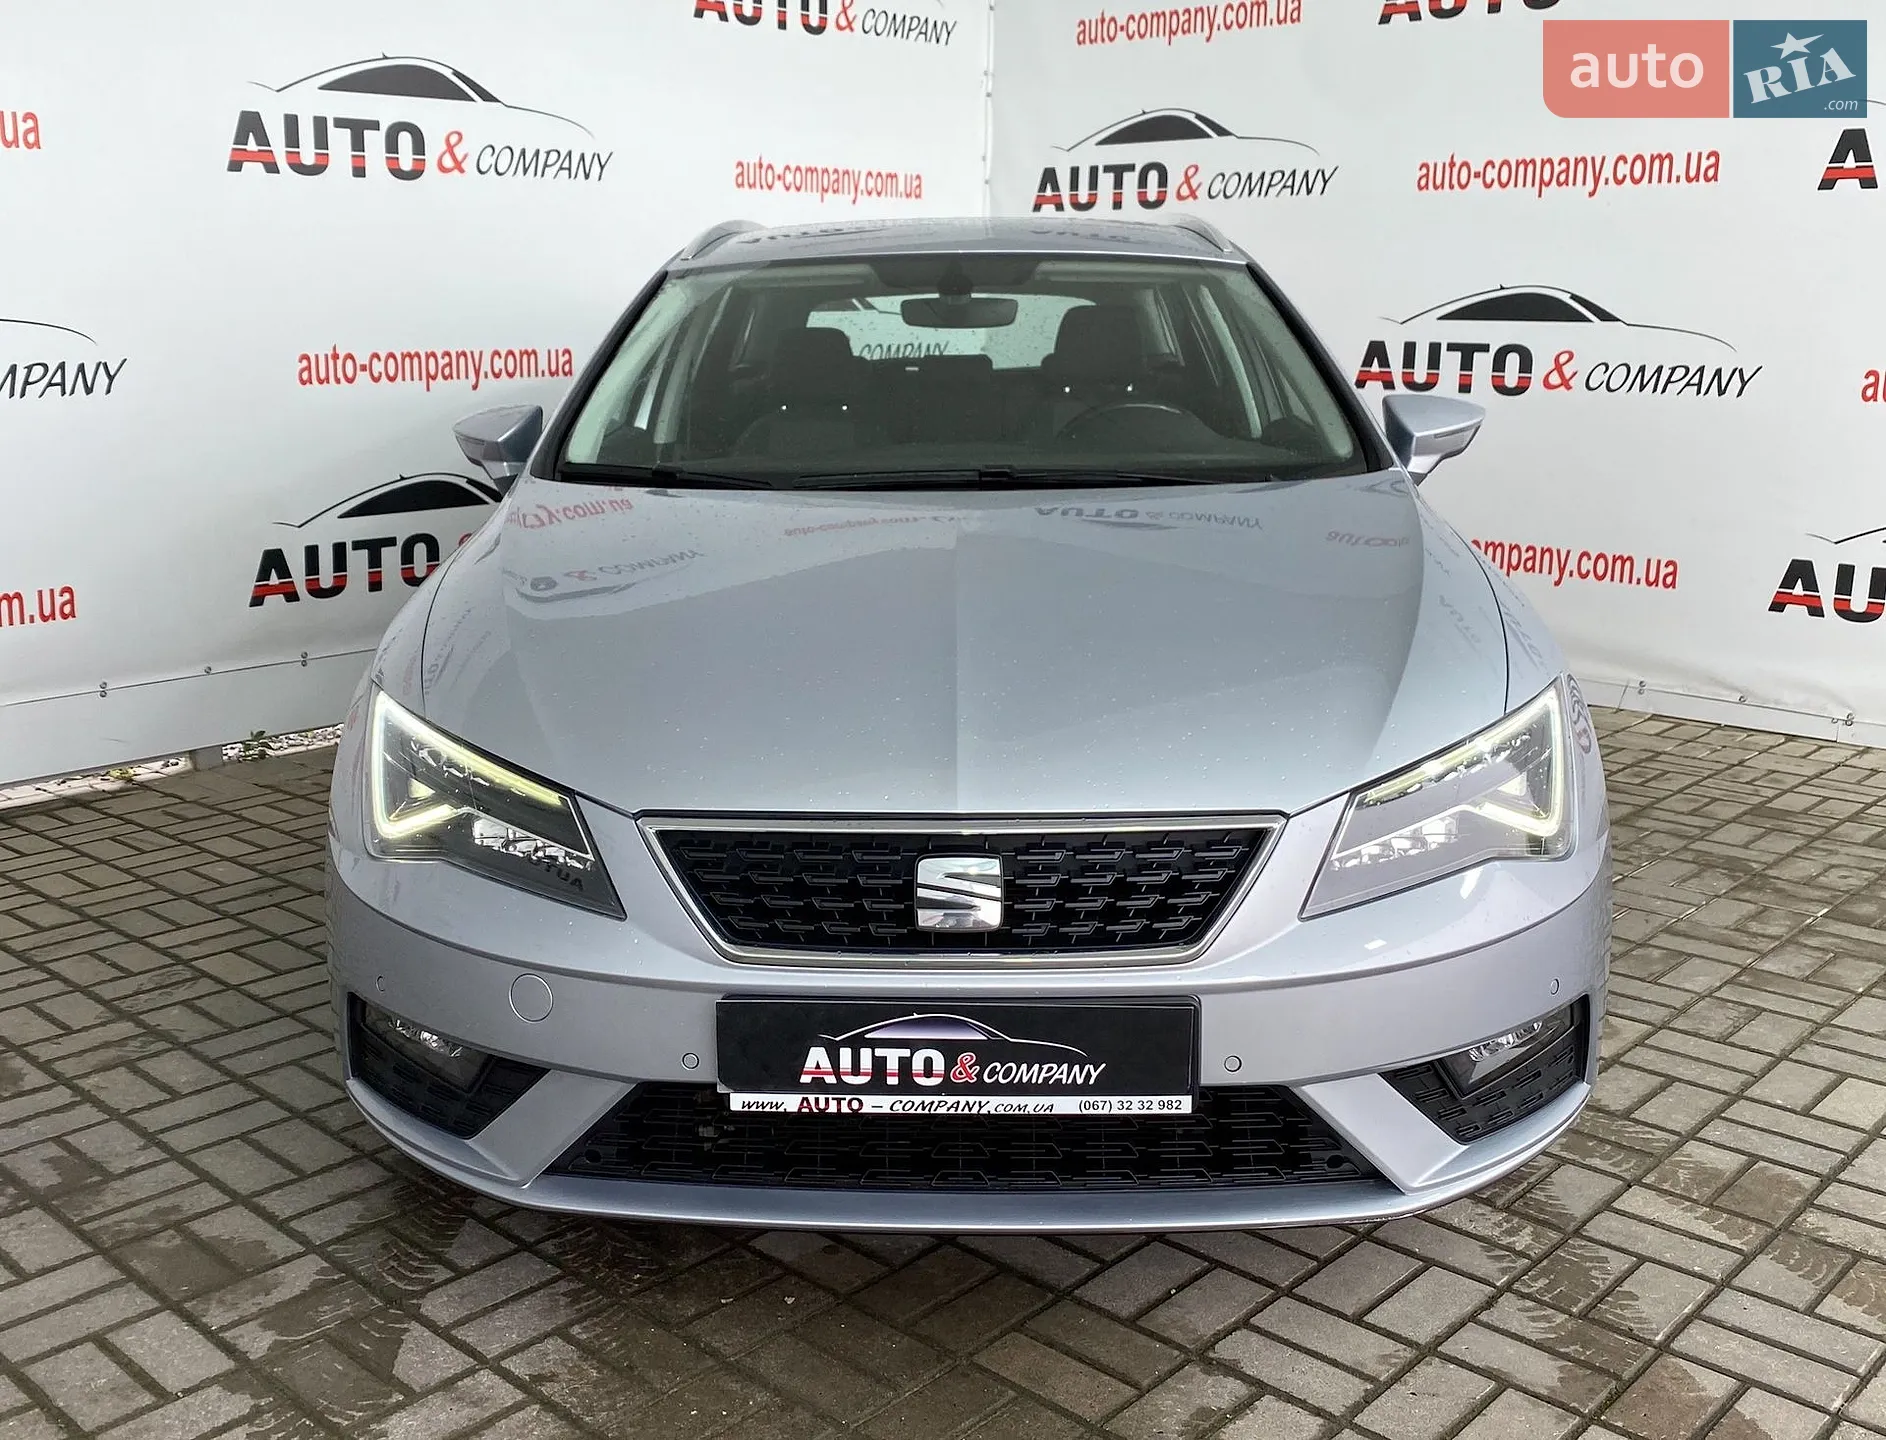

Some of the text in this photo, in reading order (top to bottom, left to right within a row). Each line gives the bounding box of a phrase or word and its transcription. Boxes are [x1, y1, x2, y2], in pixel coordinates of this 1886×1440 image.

[836, 0, 857, 32] &
[862, 8, 957, 46] COMPANY
[1076, 0, 1302, 46] auto-company.com.ua
[226, 109, 614, 182] AUTO & COMPANY
[1817, 127, 1879, 192] A
[735, 155, 922, 205] auto-company.com.ua
[1032, 161, 1340, 213] AUTO & COMPANY
[1416, 149, 1721, 198] auto-company.com.ua
[298, 342, 574, 392] auto-company.com.ua
[1355, 339, 1764, 398] AUTO & COMPANY
[249, 533, 440, 608] AUTO
[1768, 558, 1886, 624] AU
[799, 1046, 1107, 1087] AUTO & COMPANY
[796, 1096, 864, 1113] AUTO
[1078, 1099, 1113, 1112] (067)
[1116, 1099, 1134, 1111] 32
[1137, 1099, 1155, 1111] 32
[1157, 1098, 1183, 1111] 982
